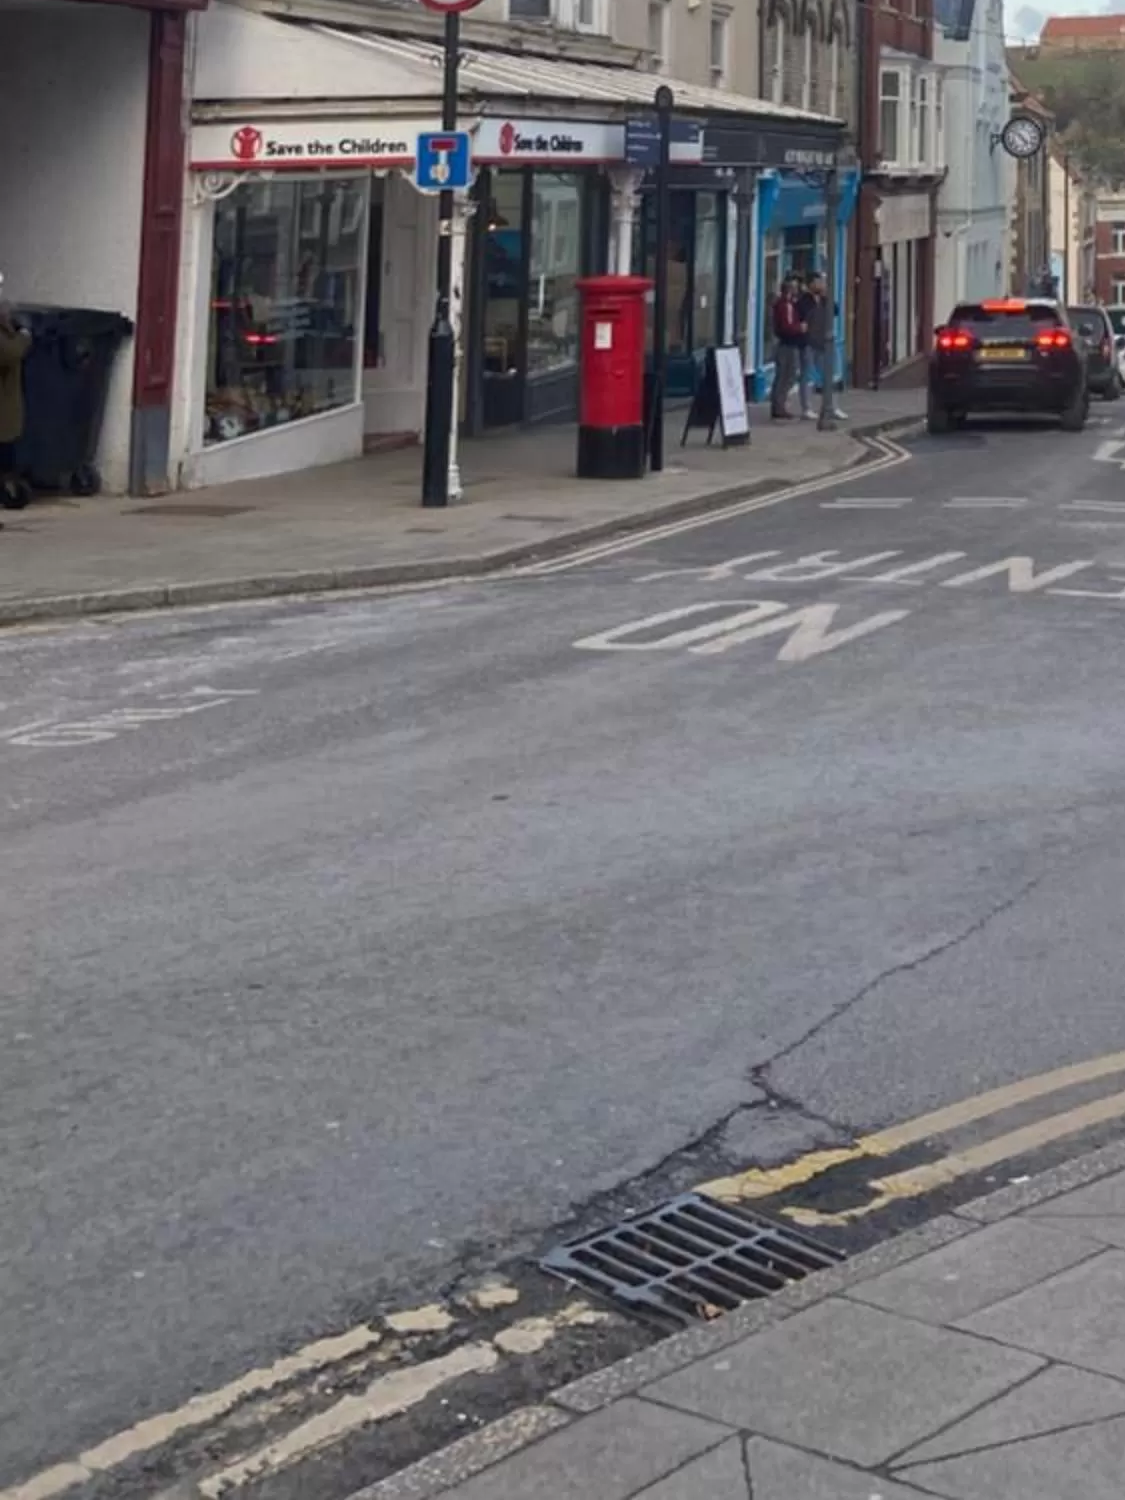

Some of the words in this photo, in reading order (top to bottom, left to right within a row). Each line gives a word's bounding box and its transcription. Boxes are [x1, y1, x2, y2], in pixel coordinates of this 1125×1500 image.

[265, 141, 302, 156] Save
[307, 140, 333, 155] the
[338, 138, 408, 154] Children
[571, 600, 913, 662] NO
